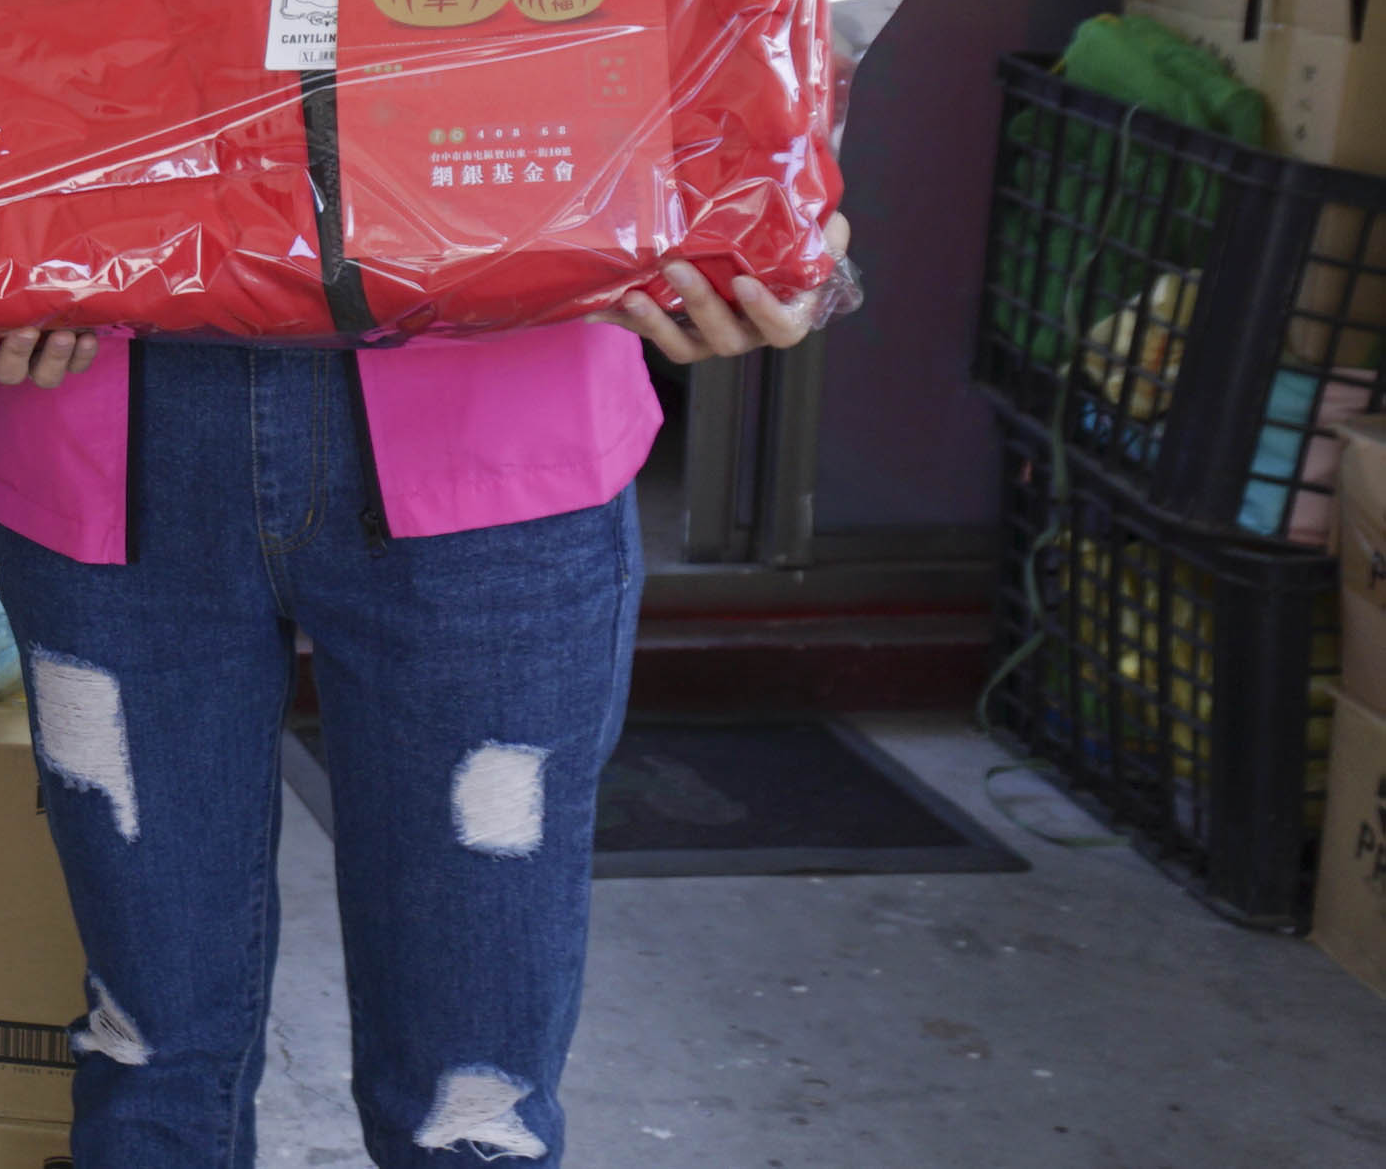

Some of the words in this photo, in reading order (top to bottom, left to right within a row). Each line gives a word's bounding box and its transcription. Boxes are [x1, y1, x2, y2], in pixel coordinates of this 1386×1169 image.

[430, 160, 575, 187] 網銀基金會
